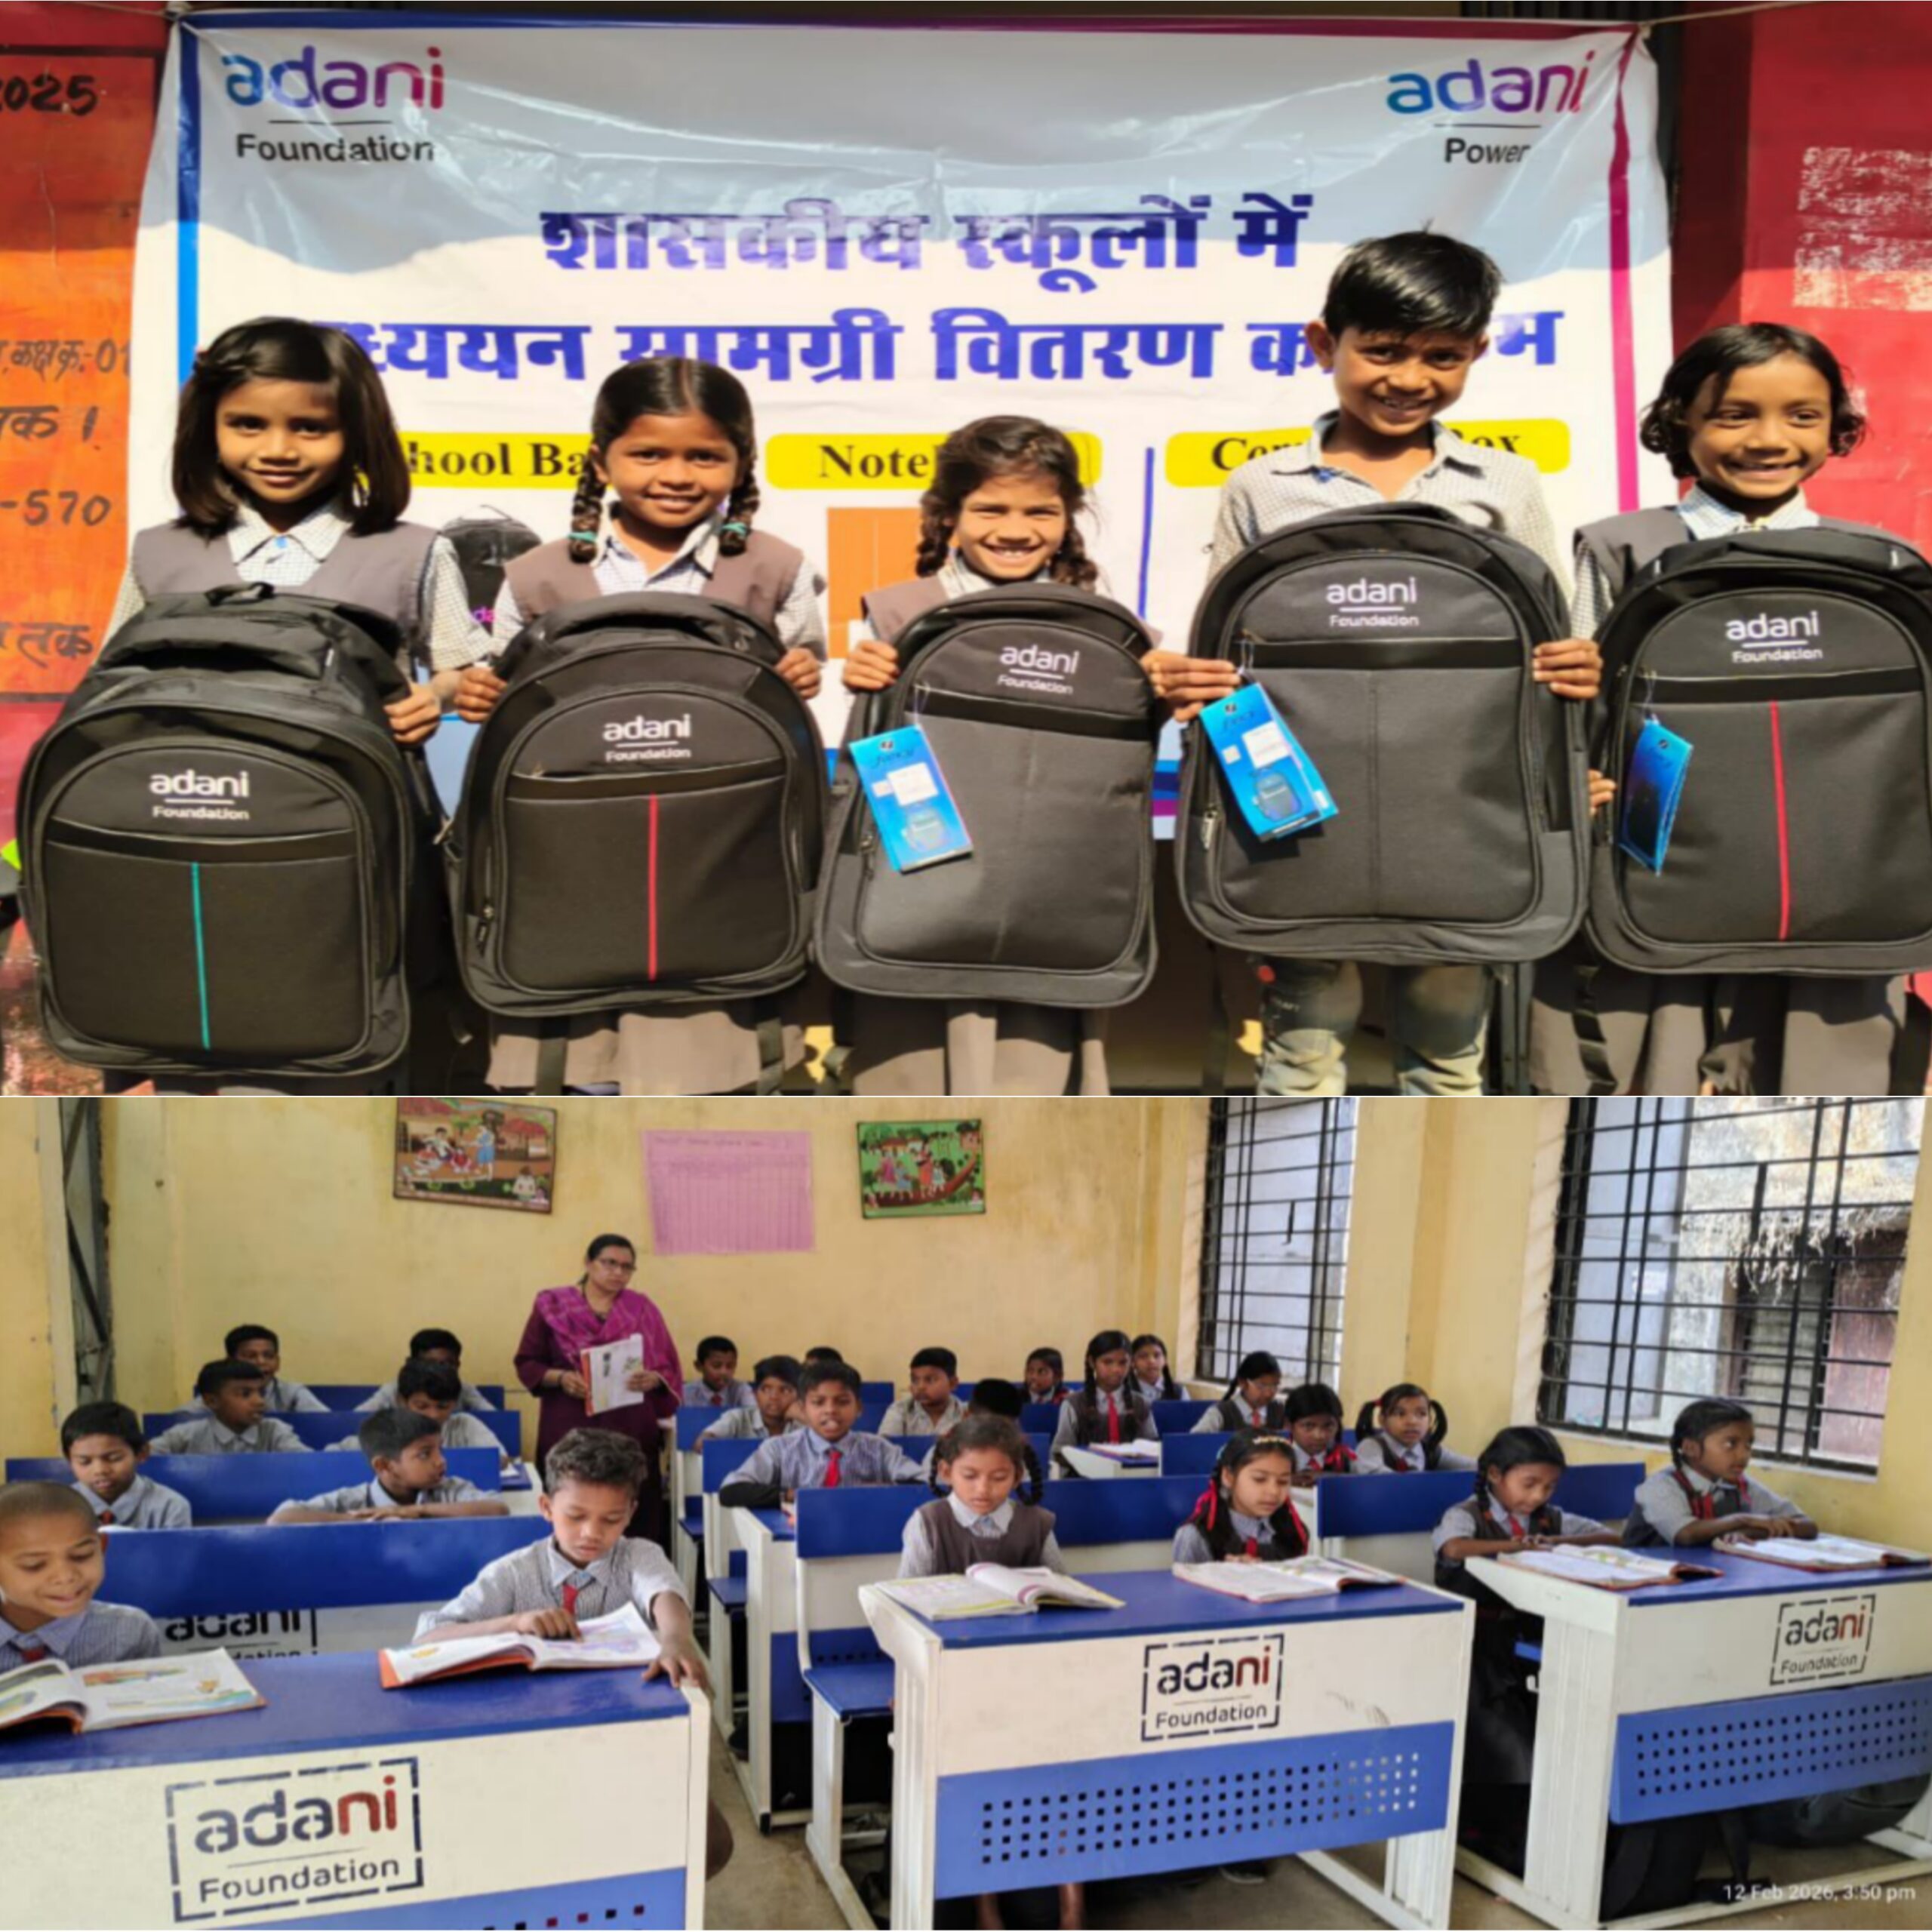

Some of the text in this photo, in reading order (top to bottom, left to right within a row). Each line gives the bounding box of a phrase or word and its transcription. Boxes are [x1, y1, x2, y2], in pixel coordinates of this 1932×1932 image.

[221, 45, 445, 109] adani
[1386, 51, 1595, 114] adani
[0, 72, 98, 116] 025
[236, 134, 435, 163] Foundation
[1444, 137, 1530, 165] Power
[540, 192, 1313, 293] शासकीय स्कूलों में
[931, 307, 1223, 379] वितरण
[408, 441, 587, 476] hool Ba
[1326, 577, 1417, 605] adani
[1329, 614, 1419, 627] Foundation
[1725, 610, 1819, 640] adani
[1001, 644, 1079, 674] adani
[1731, 648, 1823, 663] Foundation
[997, 675, 1073, 694] Foundation
[602, 713, 691, 741] adani
[605, 747, 691, 761] Foundation
[149, 768, 249, 798] adani
[152, 805, 250, 820] Foundation
[1784, 1605, 1867, 1647] adani
[1157, 1645, 1272, 1696] adani
[1780, 1652, 1858, 1675] Foundation
[1155, 1702, 1268, 1730] Foundation
[194, 1774, 397, 1854] adani
[198, 1857, 400, 1903] Foundation
